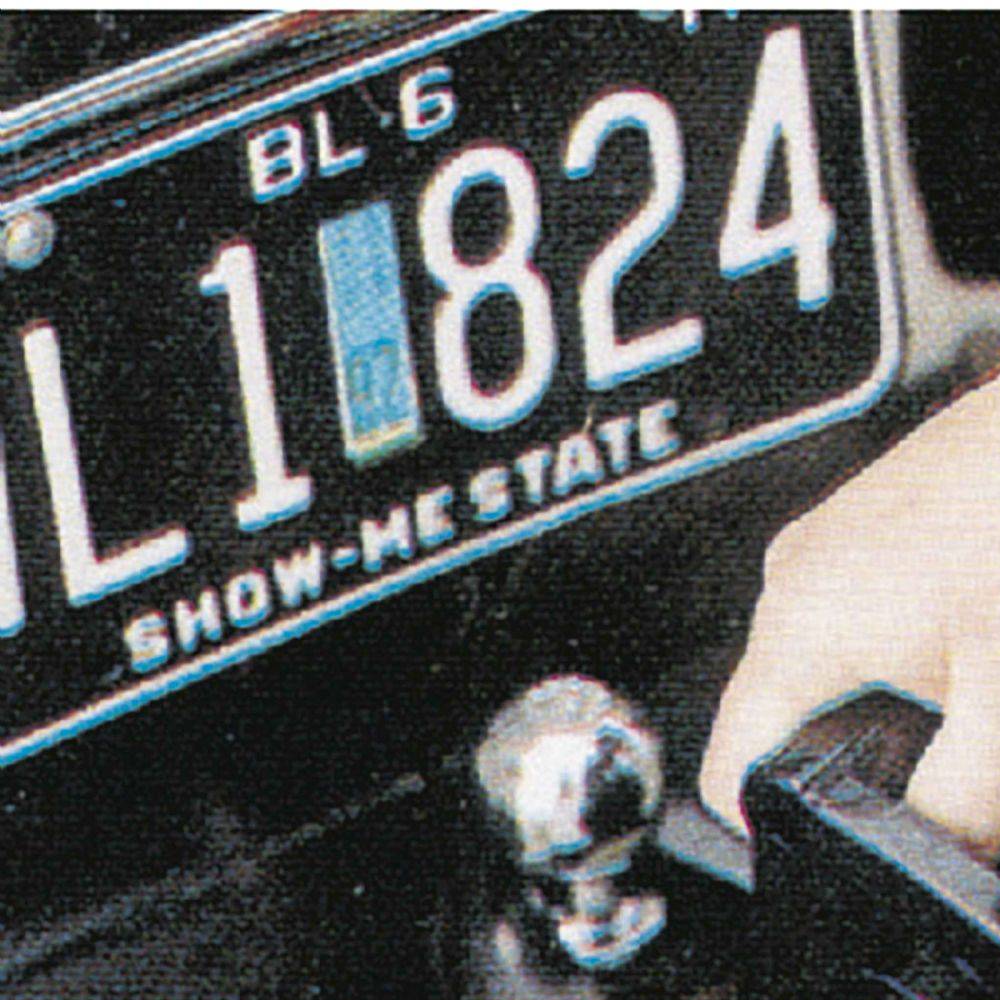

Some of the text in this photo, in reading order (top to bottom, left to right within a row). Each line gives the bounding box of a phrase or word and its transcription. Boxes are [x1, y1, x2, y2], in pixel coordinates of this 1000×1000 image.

[247, 62, 457, 203] BL 6
[123, 400, 680, 674] SHOW-ME STATE
